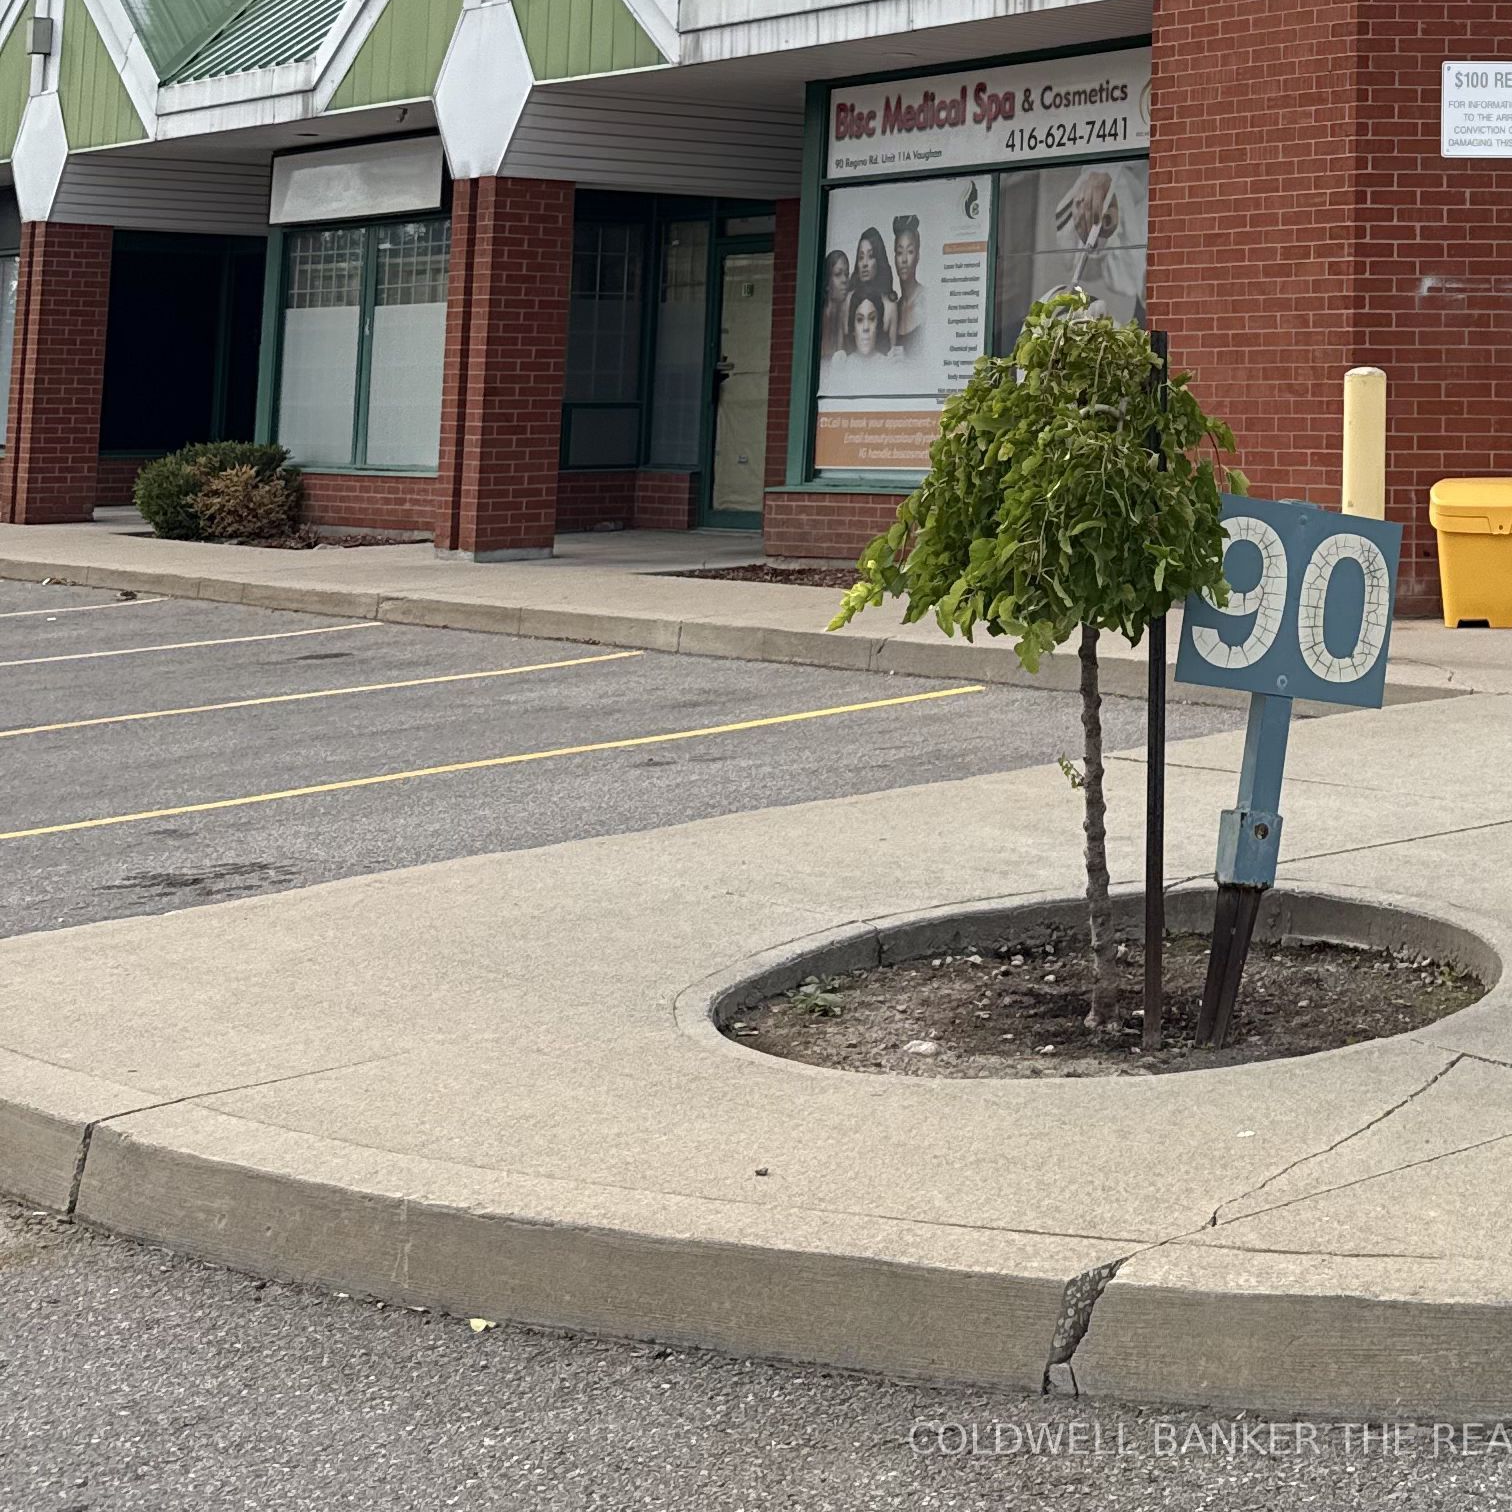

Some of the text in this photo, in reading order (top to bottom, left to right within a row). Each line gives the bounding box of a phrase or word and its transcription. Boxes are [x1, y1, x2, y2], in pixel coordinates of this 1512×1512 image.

[1454, 71, 1489, 90] $100
[835, 79, 1128, 141] Bisc Medical Spa & Cosmetics
[1448, 100, 1466, 109] FOR
[1463, 113, 1475, 122] TO
[1478, 113, 1493, 122] THE
[1005, 117, 1128, 153] 416-624-7441
[1453, 125, 1506, 135] CONVICTION
[1448, 138, 1493, 147] DAMAGING
[835, 158, 844, 169] 90
[913, 148, 942, 161] Vaughan
[1192, 516, 1390, 683] 90
